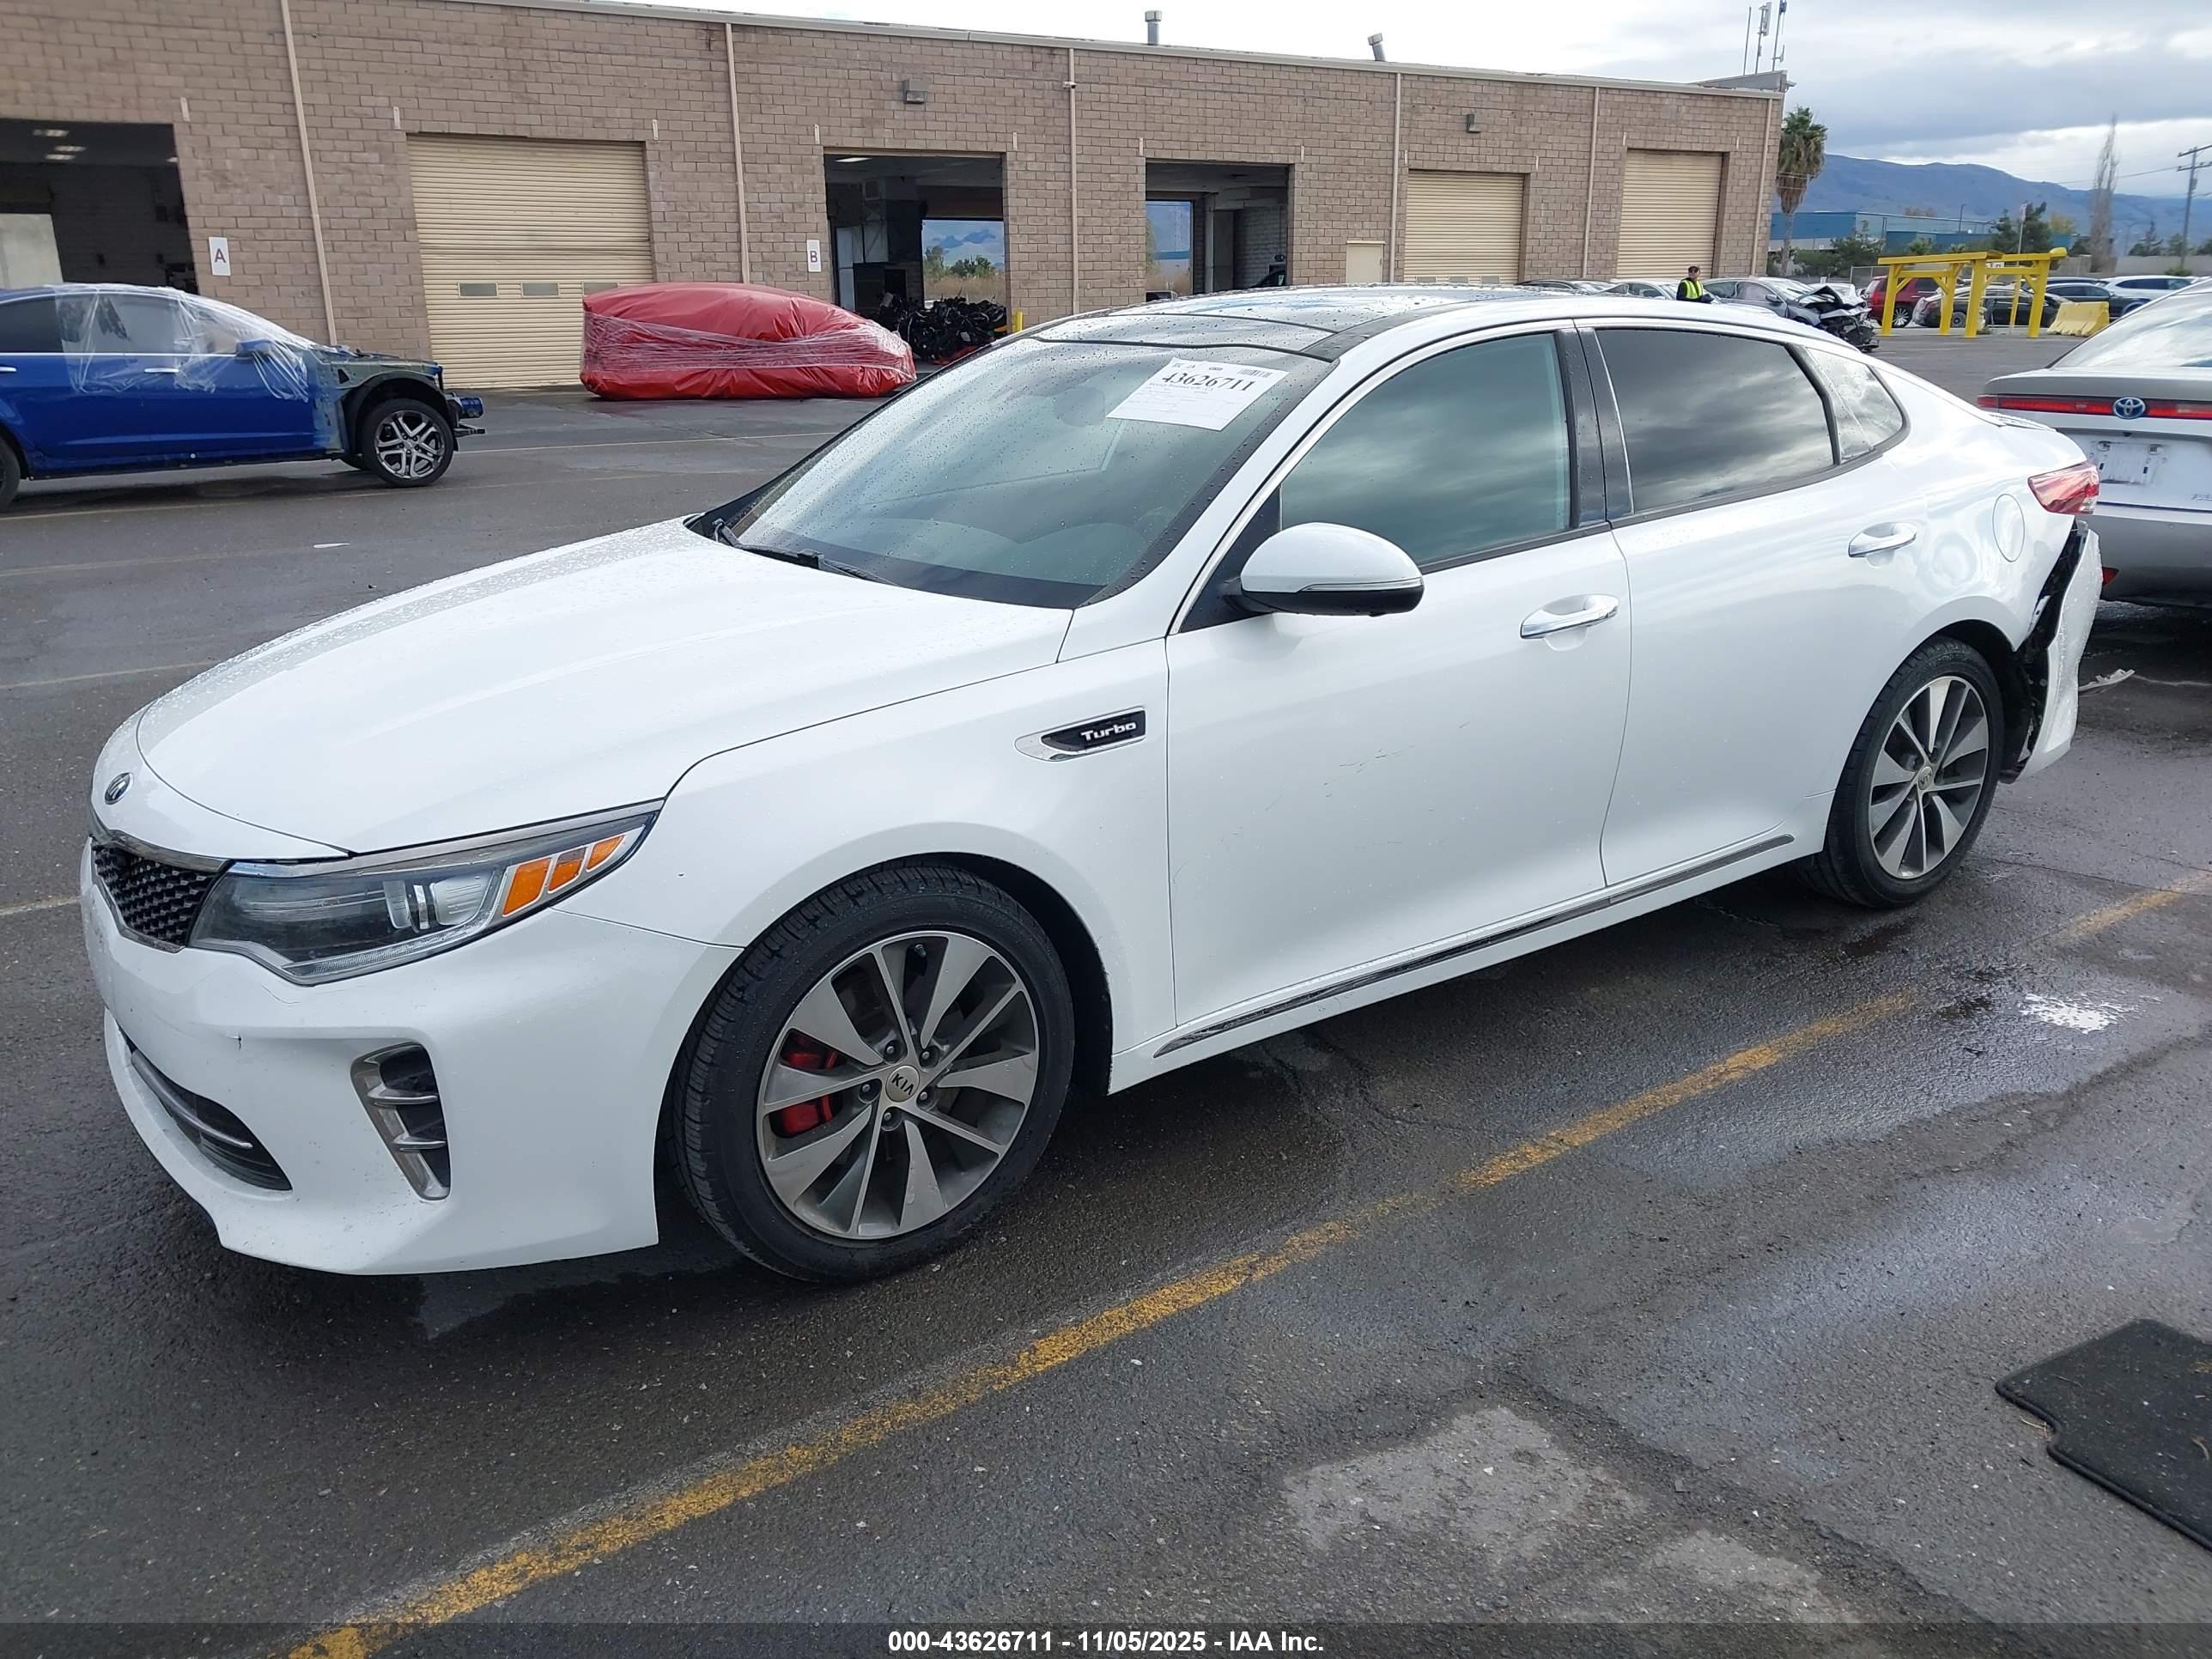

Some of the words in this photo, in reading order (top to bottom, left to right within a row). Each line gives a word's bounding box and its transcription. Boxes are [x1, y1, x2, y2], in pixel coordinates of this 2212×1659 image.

[215, 248, 226, 263] A
[810, 250, 818, 263] B
[1162, 372, 1255, 391] 43626711
[1080, 721, 1137, 741] Turbo
[891, 1073, 915, 1096] KIA
